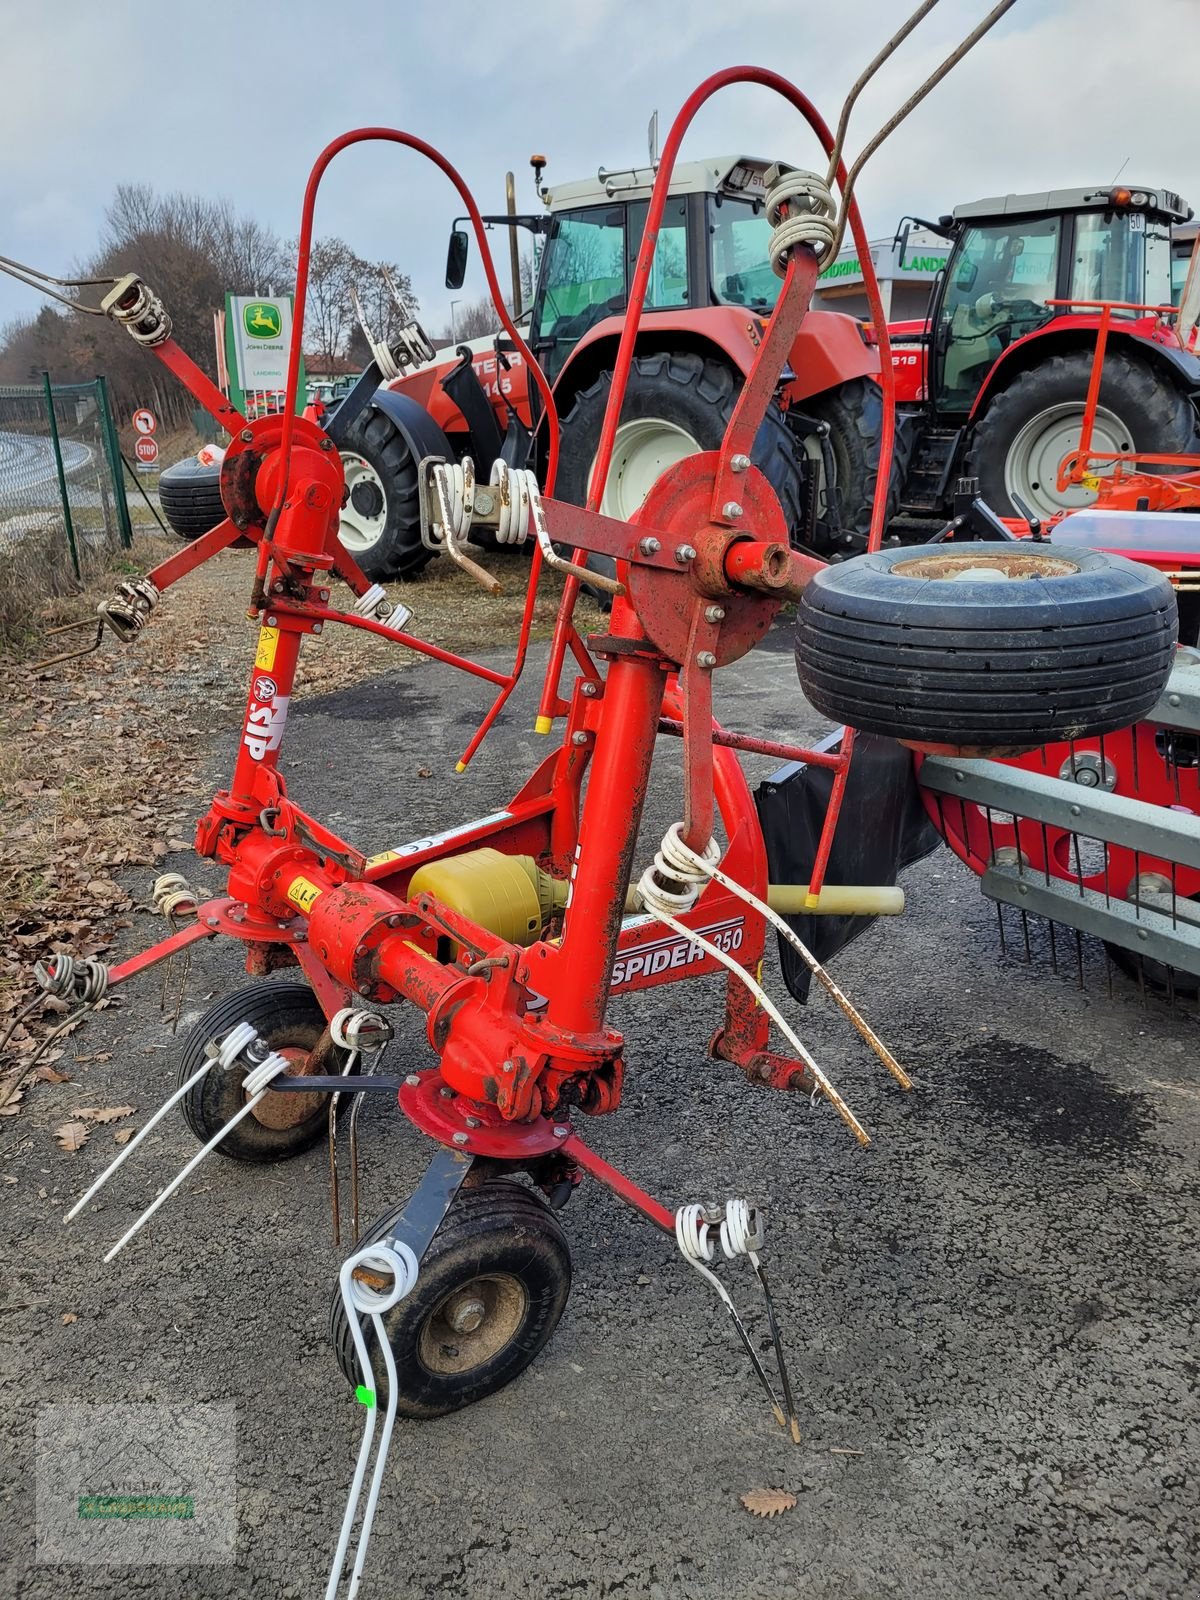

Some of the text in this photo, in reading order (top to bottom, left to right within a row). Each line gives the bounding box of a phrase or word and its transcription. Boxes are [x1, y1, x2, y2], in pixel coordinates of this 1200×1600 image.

[1130, 213, 1141, 230] 50
[138, 444, 156, 456] STOP
[610, 927, 743, 987] SPIDER 350
